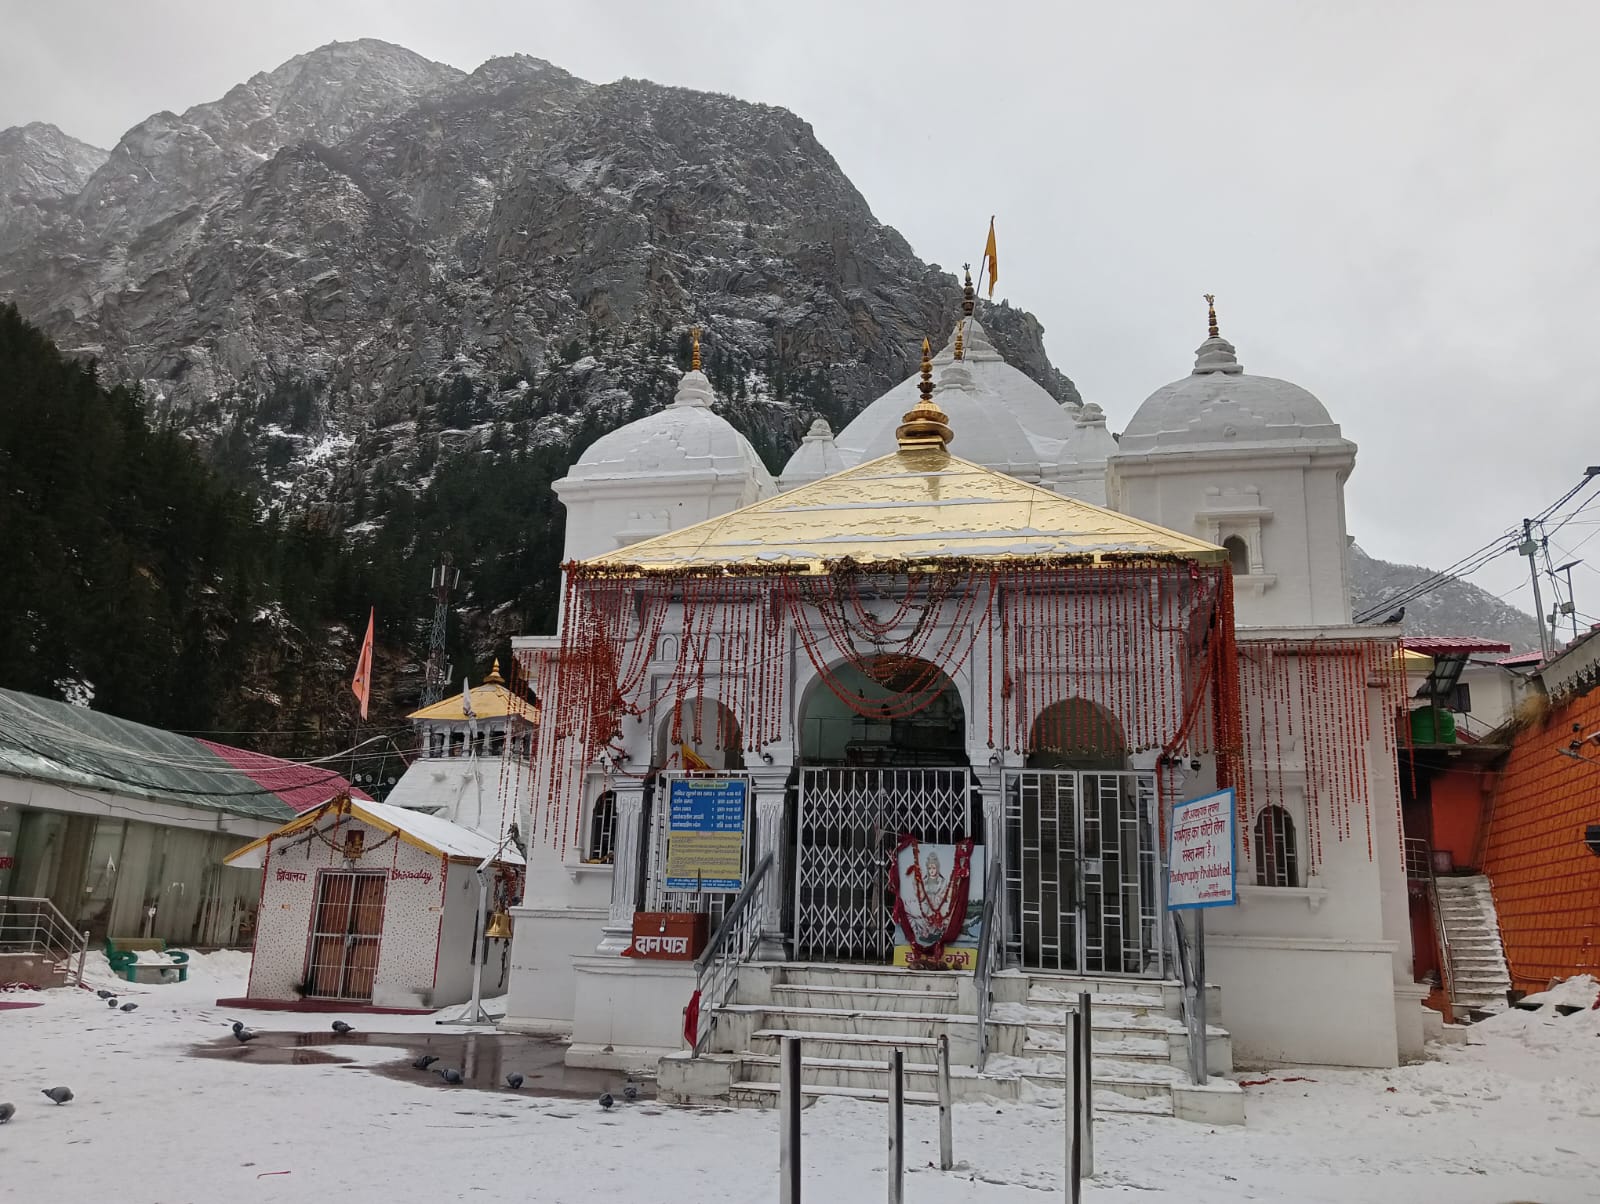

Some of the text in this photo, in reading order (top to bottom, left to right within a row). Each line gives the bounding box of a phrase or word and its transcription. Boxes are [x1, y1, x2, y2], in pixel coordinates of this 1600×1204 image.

[1191, 826, 1200, 838] का
[1200, 818, 1213, 837] फोटो
[1213, 816, 1226, 835] लेना
[635, 935, 689, 955] दान पात्र
